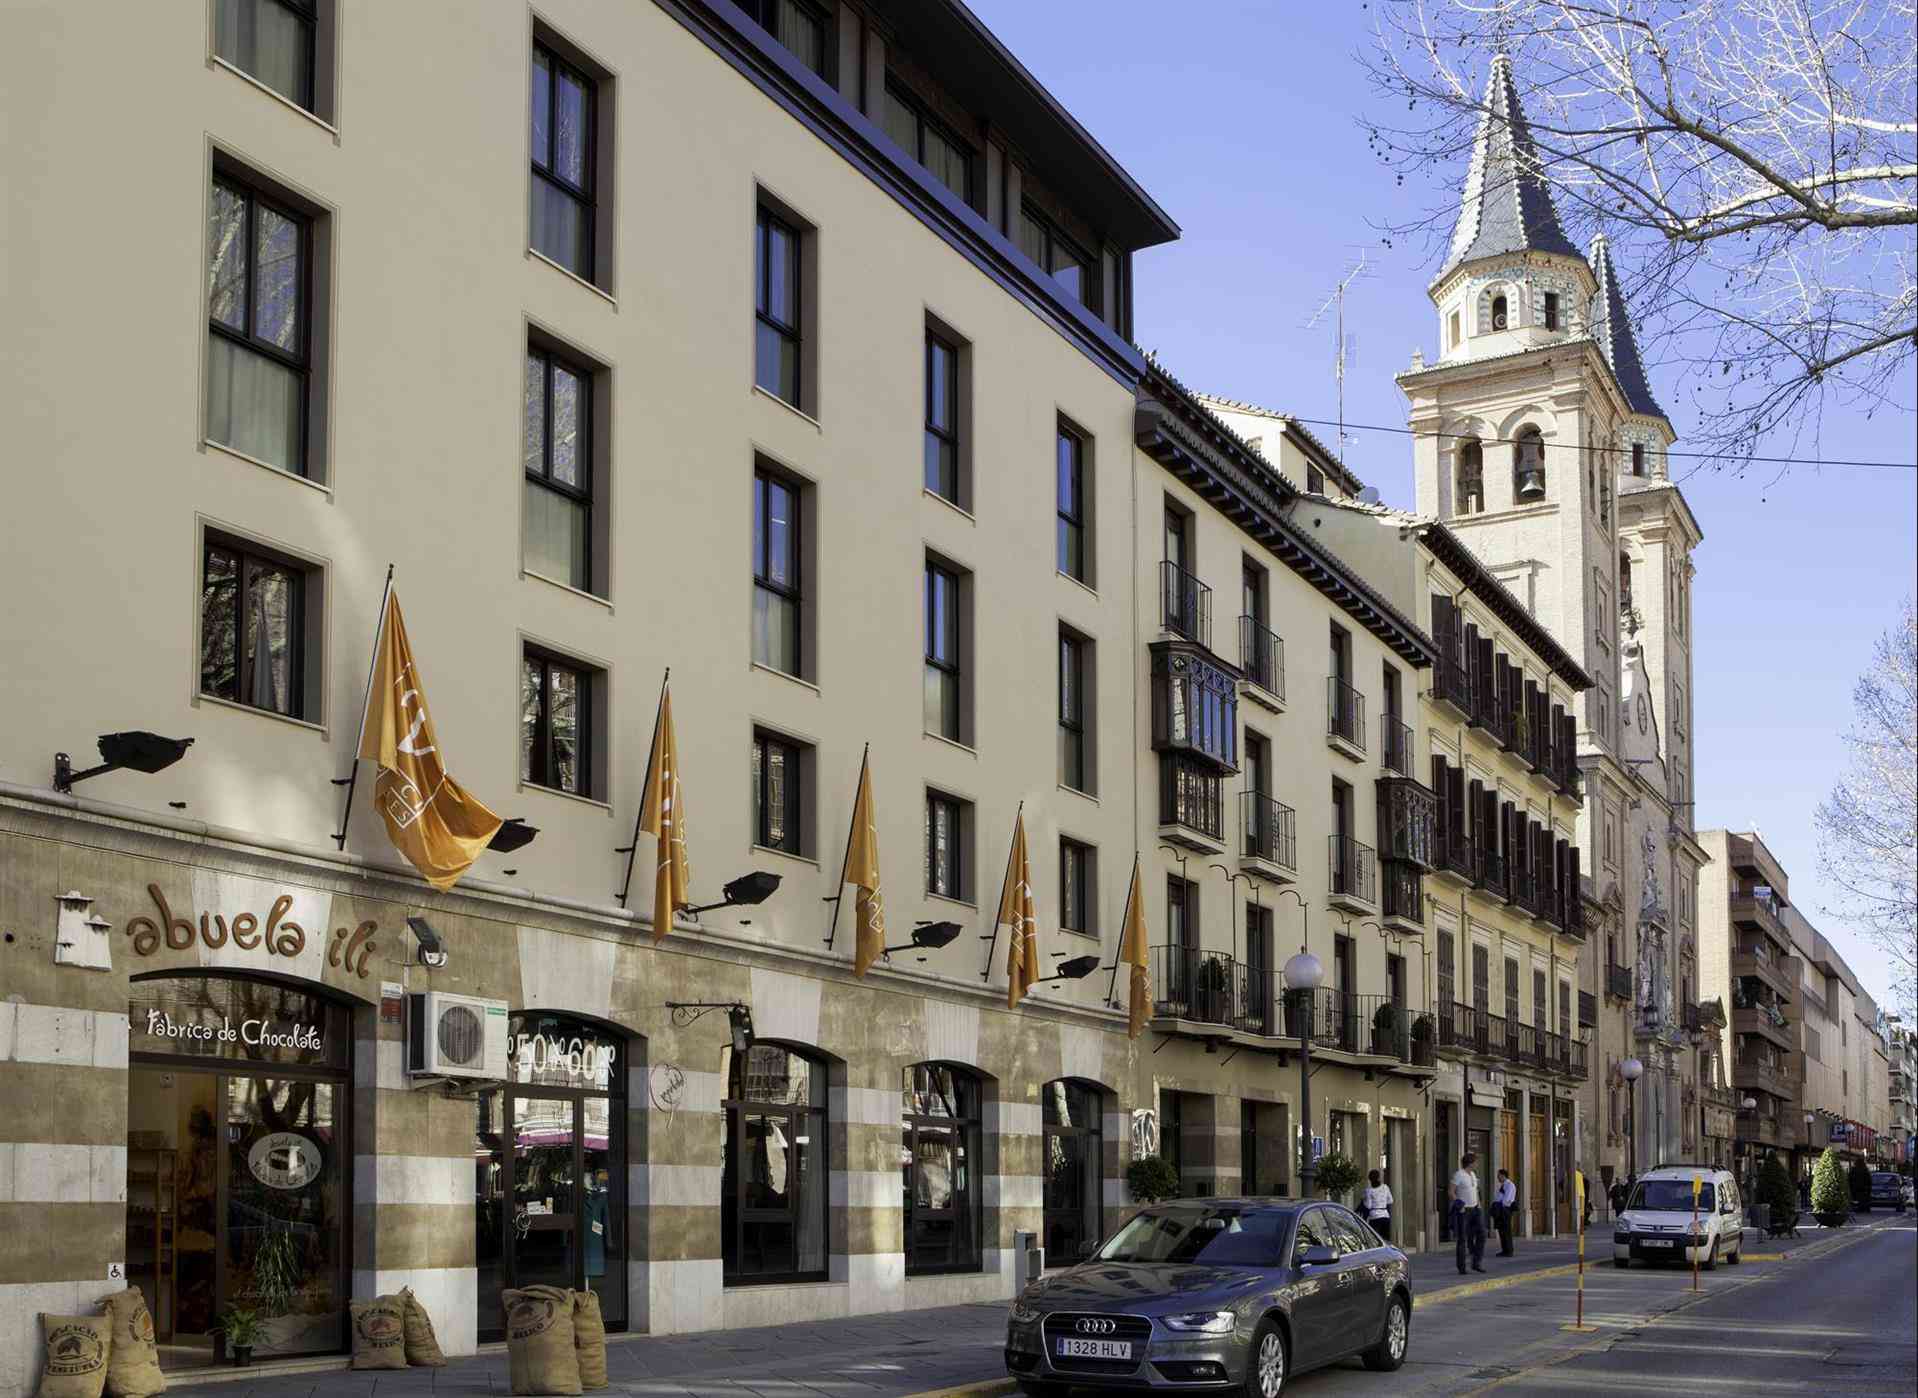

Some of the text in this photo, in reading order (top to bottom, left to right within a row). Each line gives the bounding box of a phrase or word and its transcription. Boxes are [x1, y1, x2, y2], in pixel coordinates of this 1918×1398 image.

[126, 883, 378, 979] abuela ili
[217, 1016, 237, 1042] de
[241, 1019, 321, 1050] Chocolate
[1067, 1341, 1128, 1357] 1328 HLV
